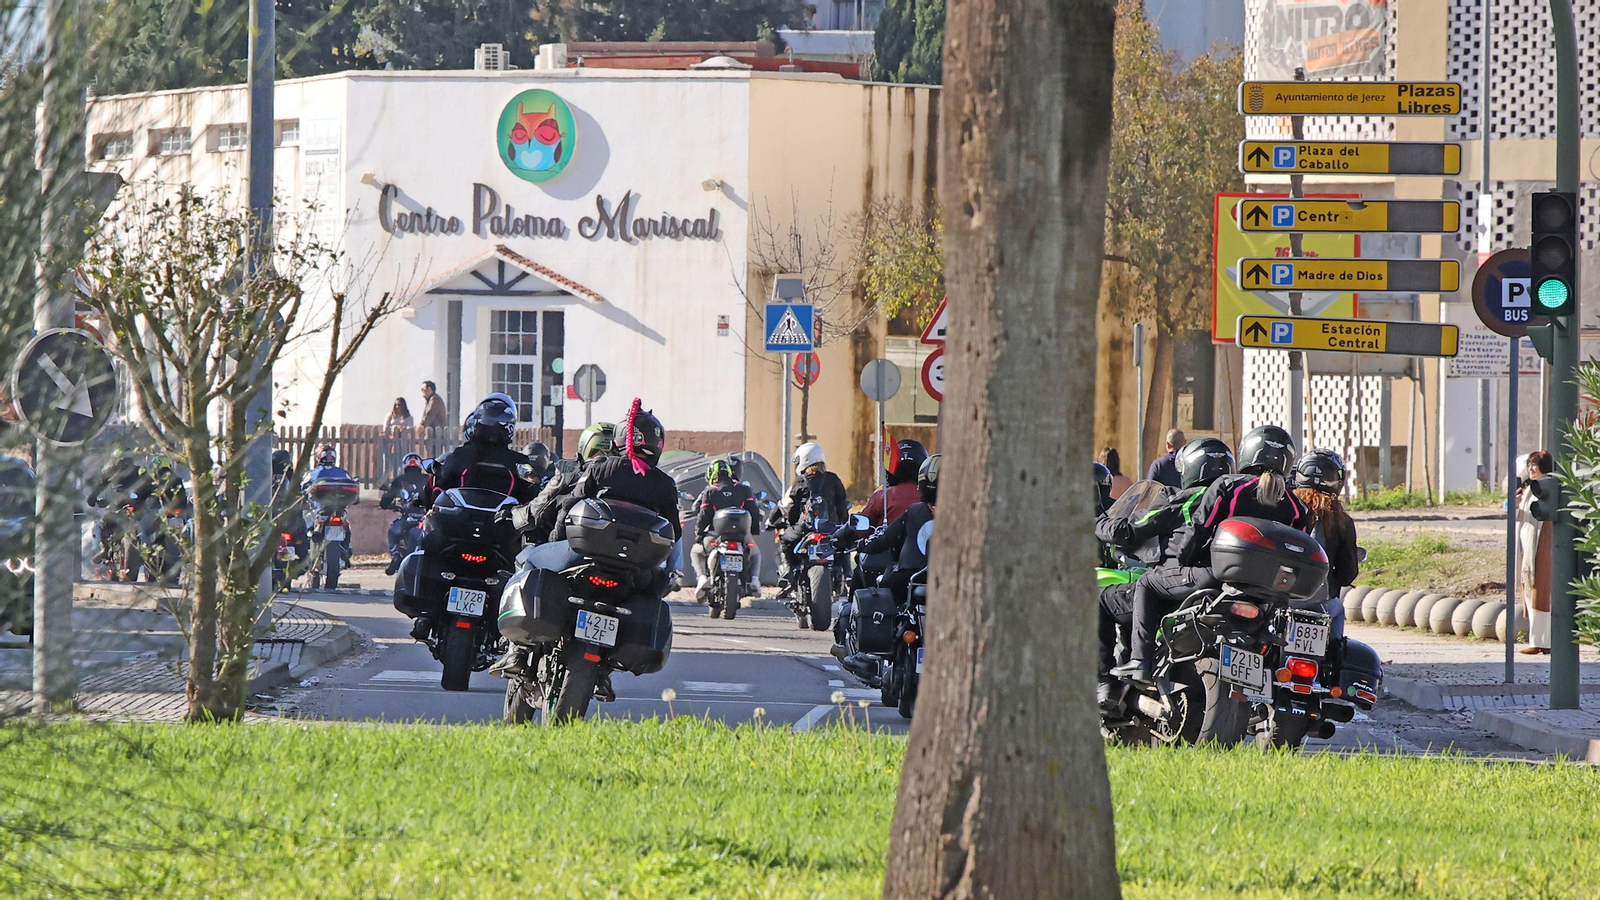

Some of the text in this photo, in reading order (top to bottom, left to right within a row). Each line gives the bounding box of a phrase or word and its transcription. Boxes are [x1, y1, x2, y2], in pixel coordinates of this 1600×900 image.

[1274, 3, 1371, 48] NITRO
[1397, 84, 1456, 97] Plazas
[1275, 92, 1386, 105] Ayuntamiento de Jerez
[1397, 101, 1452, 114] Libres
[1278, 149, 1292, 166] P
[1299, 145, 1360, 157] Plaza del
[1299, 158, 1350, 170] Caballo
[378, 182, 720, 243] Centro Paloma Mariscal
[1277, 208, 1291, 224] P
[1275, 265, 1290, 284] P
[1298, 270, 1383, 281] Madre de Dios
[1508, 283, 1525, 303] P
[1504, 309, 1529, 321] BUS
[1274, 325, 1290, 343] P
[1321, 322, 1381, 336] Estación
[1328, 336, 1379, 349] Central
[458, 590, 484, 604] 1728
[455, 601, 476, 613] LXC
[586, 614, 616, 632] 4215
[584, 626, 607, 640] LZF
[1296, 625, 1325, 641] 6831
[1294, 640, 1315, 653] FVL
[1230, 649, 1261, 669] 7219
[1230, 664, 1253, 680] GFF
